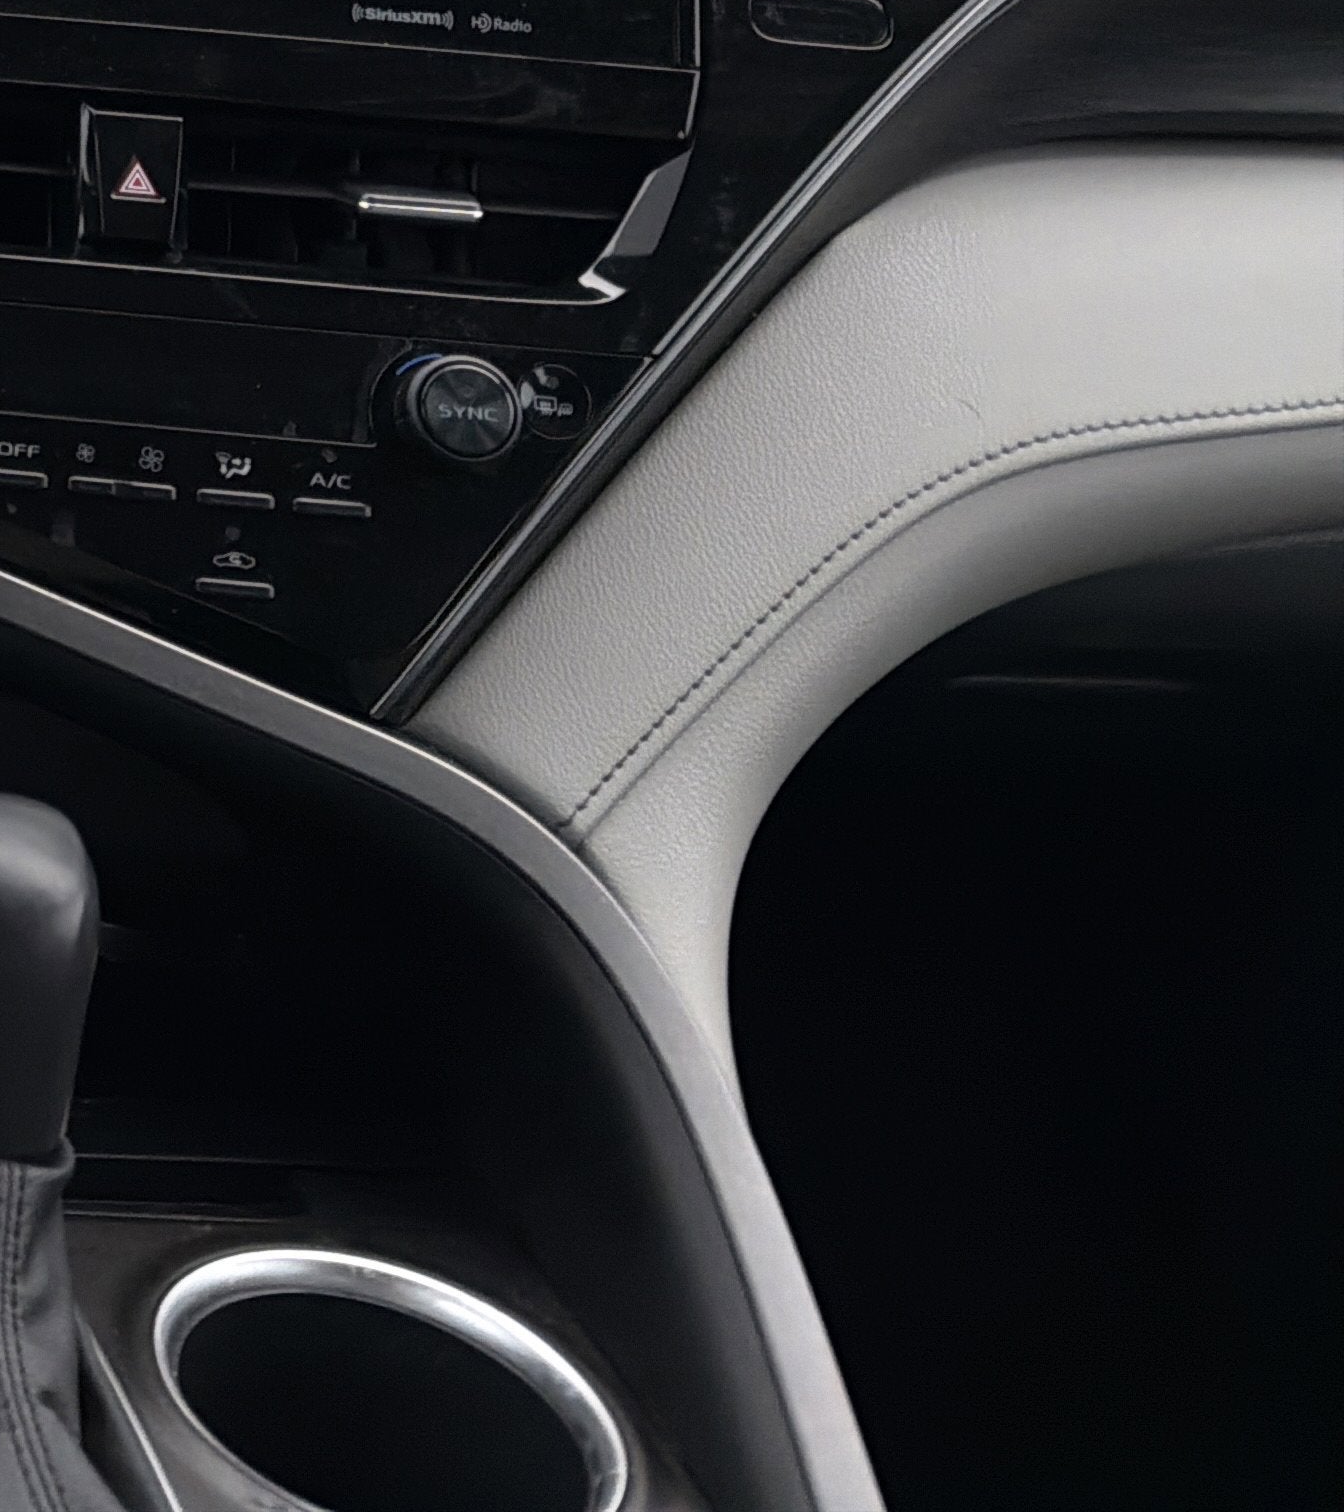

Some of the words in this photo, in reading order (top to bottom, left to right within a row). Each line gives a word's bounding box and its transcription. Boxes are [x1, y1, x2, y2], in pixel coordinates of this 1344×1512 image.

[493, 17, 533, 34] Radio
[437, 403, 499, 423] SYNC
[310, 471, 352, 490] A/C
